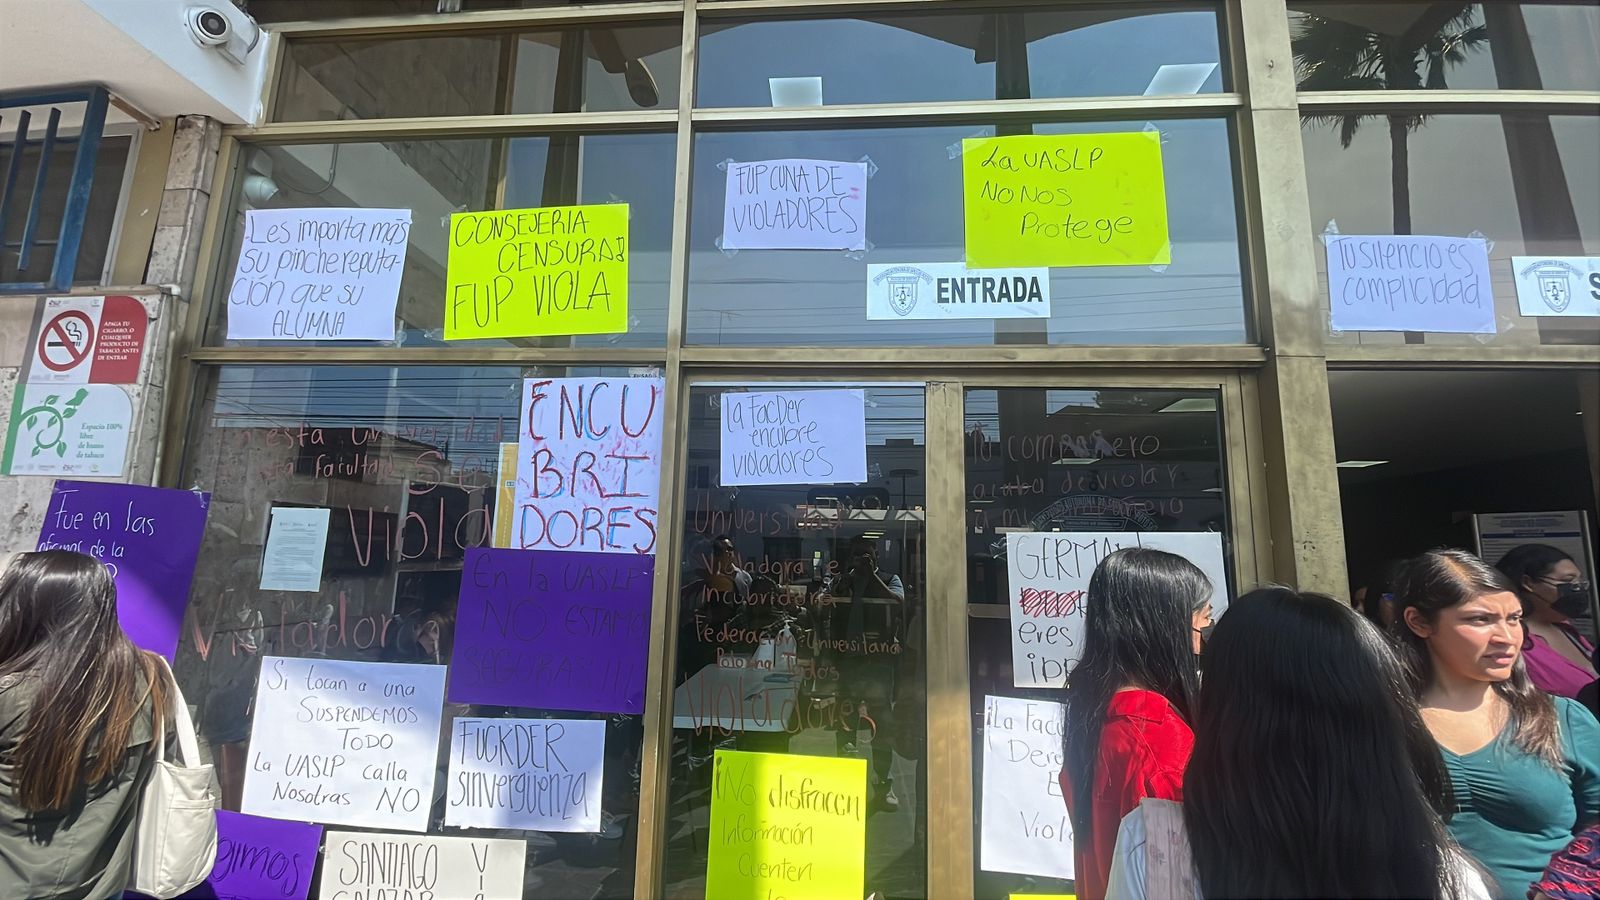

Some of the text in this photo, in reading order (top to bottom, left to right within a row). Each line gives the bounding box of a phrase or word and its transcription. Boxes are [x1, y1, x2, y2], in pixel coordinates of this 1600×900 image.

[981, 145, 1103, 172] La UASLP
[736, 165, 846, 196] FUP CUNA DE
[455, 209, 590, 247] CONSEJERIA
[733, 196, 858, 234] VIOLADORES
[1021, 212, 1133, 244] Protege
[250, 216, 290, 243] Les
[298, 216, 367, 248] importa
[274, 249, 339, 279] pinche
[1360, 240, 1442, 271] silencio
[1448, 243, 1474, 276] es
[292, 283, 332, 313] que
[453, 270, 611, 330] FUP VIOLA
[937, 276, 1043, 304] ENTRADA
[1343, 273, 1481, 311] complicidad
[272, 310, 345, 338] ALUMNA
[529, 380, 656, 440] ENCU
[265, 420, 325, 450] esta
[749, 421, 819, 448] encubre
[531, 448, 650, 499] BRI
[732, 445, 834, 477] violadores
[55, 489, 155, 536] Fue en las
[520, 503, 657, 554] DORES
[90, 539, 106, 558] de
[111, 541, 124, 557] la
[473, 552, 644, 592] En la UASLP
[481, 599, 547, 642] NO
[1018, 622, 1073, 647] eres
[267, 660, 415, 698] Si tocan a una
[459, 720, 568, 772] FUCKDER
[254, 752, 407, 782] La UASLP calla
[273, 781, 420, 813] Nosotras NO
[340, 840, 438, 890] SANTIAGO
[738, 852, 813, 882] Cuenten
